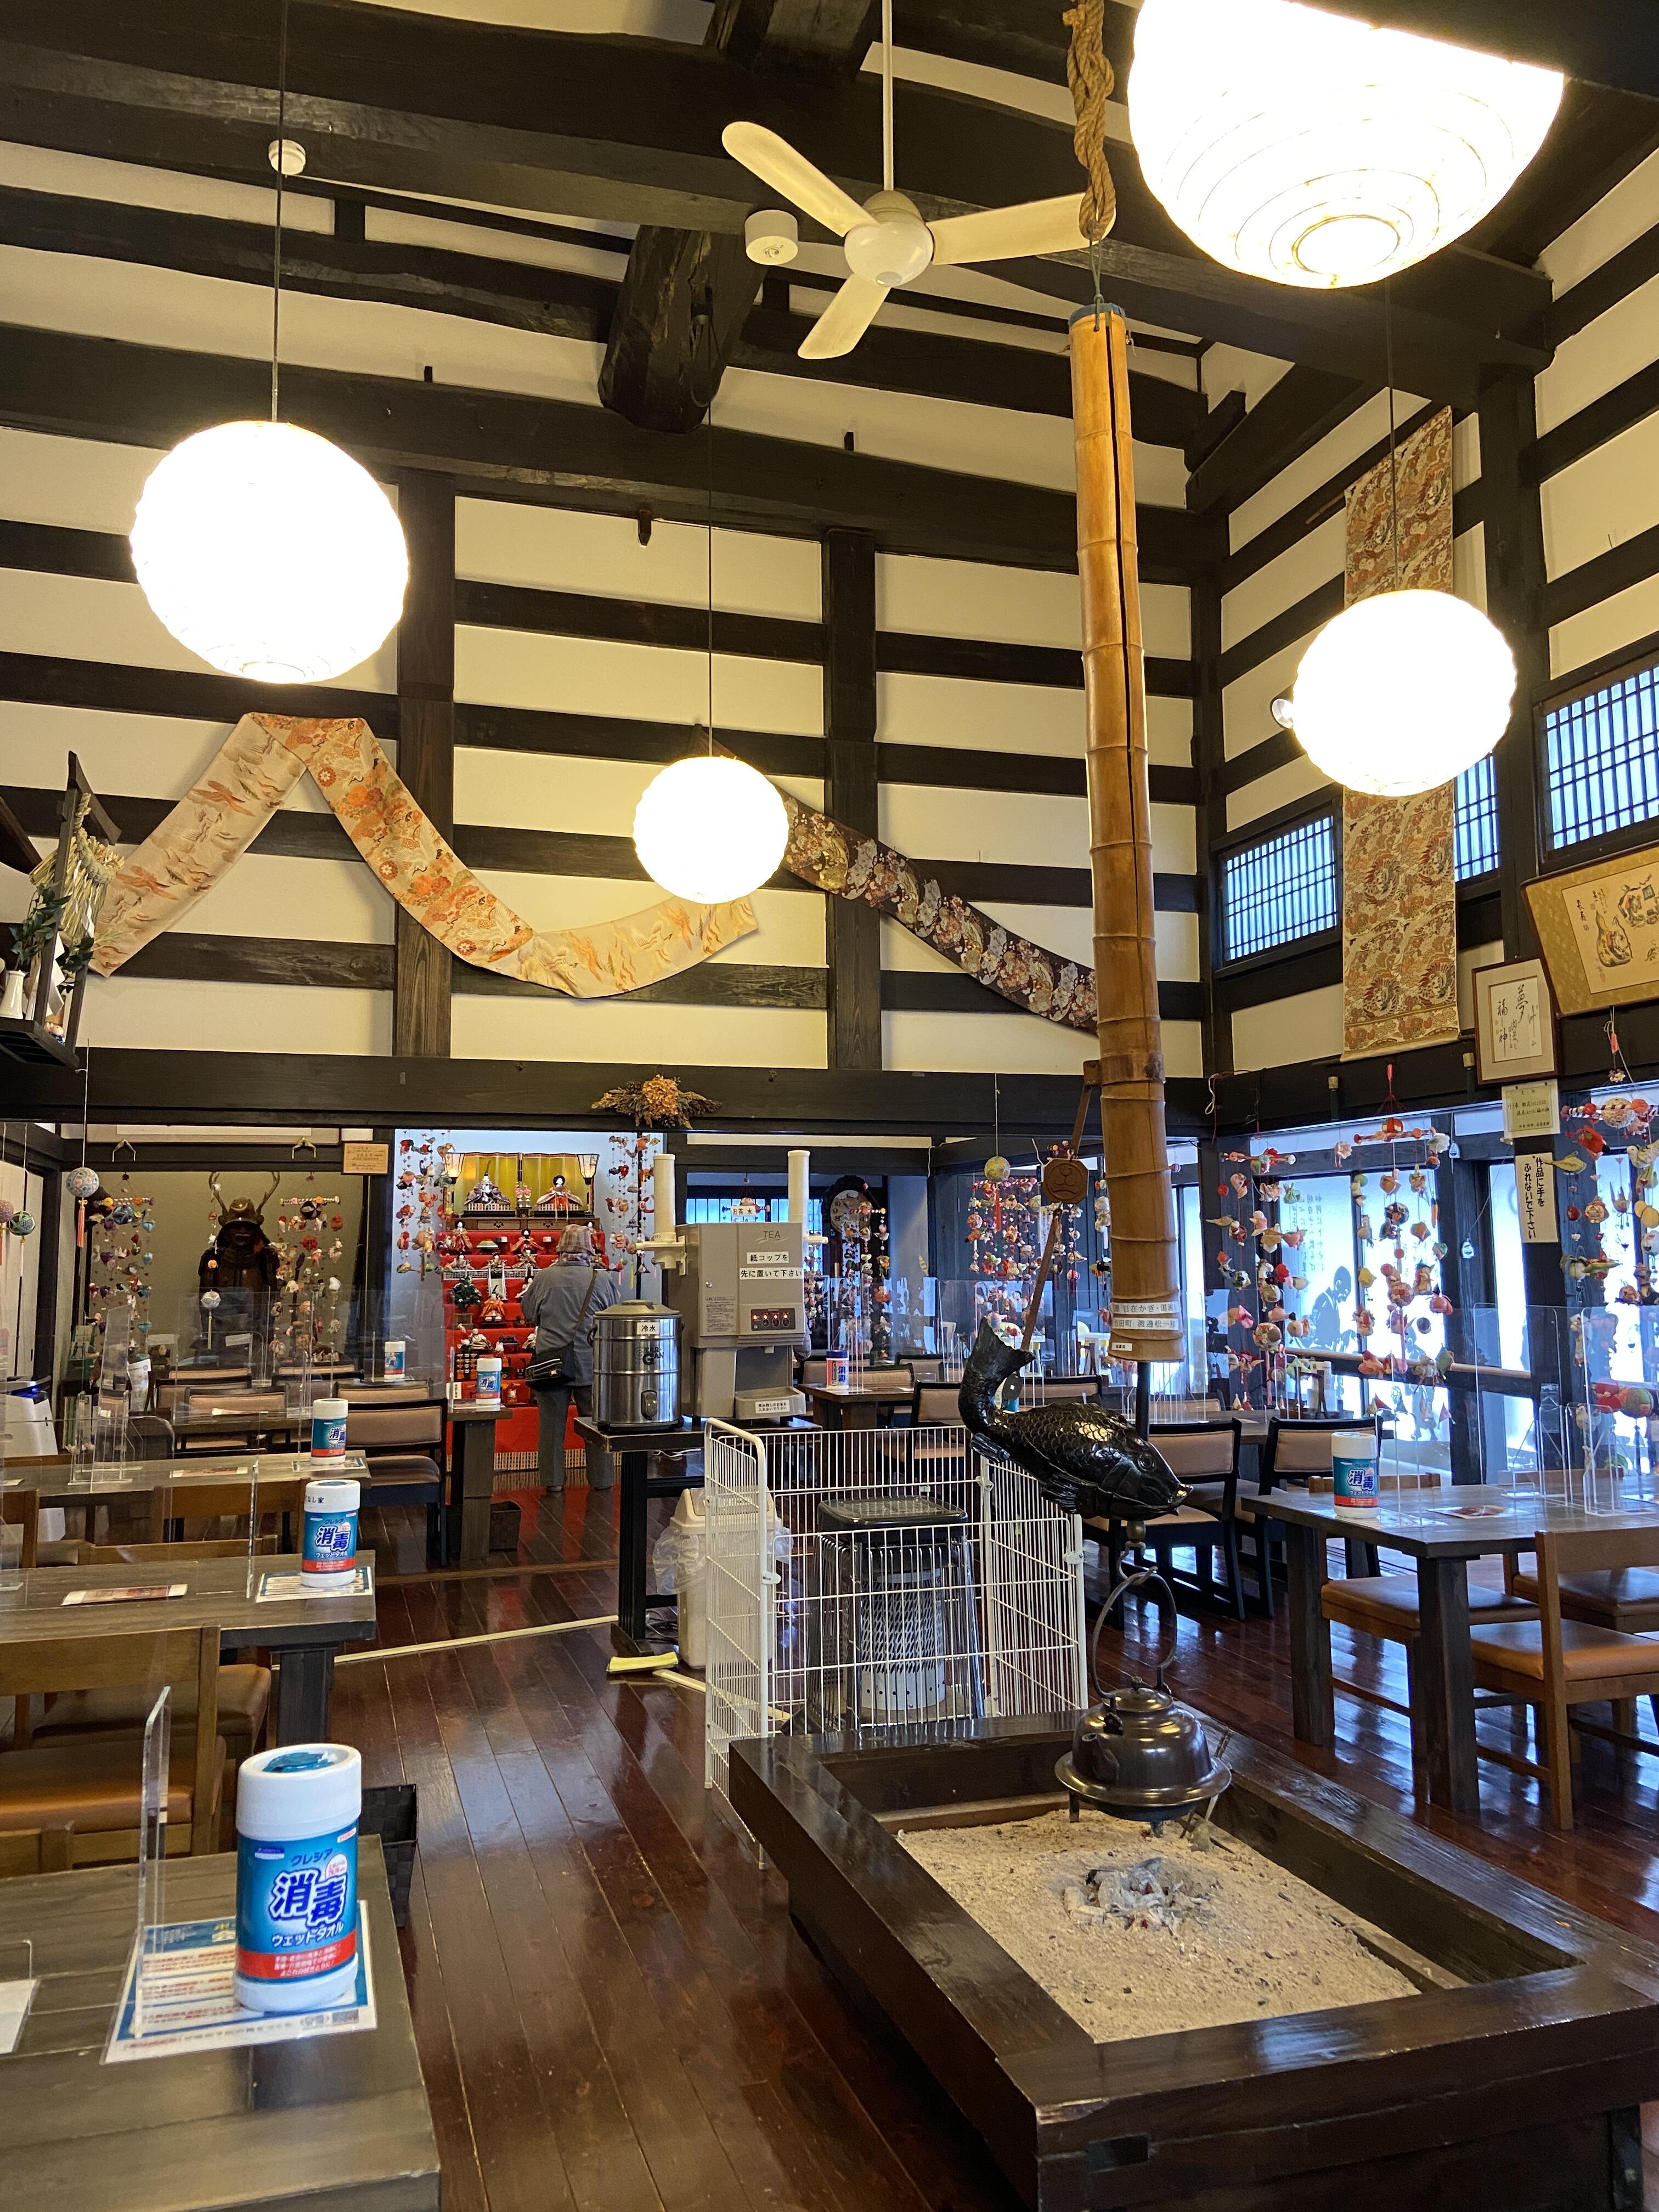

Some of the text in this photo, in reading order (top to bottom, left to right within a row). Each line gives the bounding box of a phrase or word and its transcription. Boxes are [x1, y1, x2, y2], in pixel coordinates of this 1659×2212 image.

[1536, 1157, 1545, 1207] 作品に手を
[1525, 1163, 1536, 1239] ふれないで下さい
[763, 1231, 781, 1240] TEA
[1348, 1470, 1374, 1490] 消毒
[315, 1526, 351, 1551] 消毒
[291, 1848, 334, 1866] クレシア
[269, 1867, 348, 1929] 消毒
